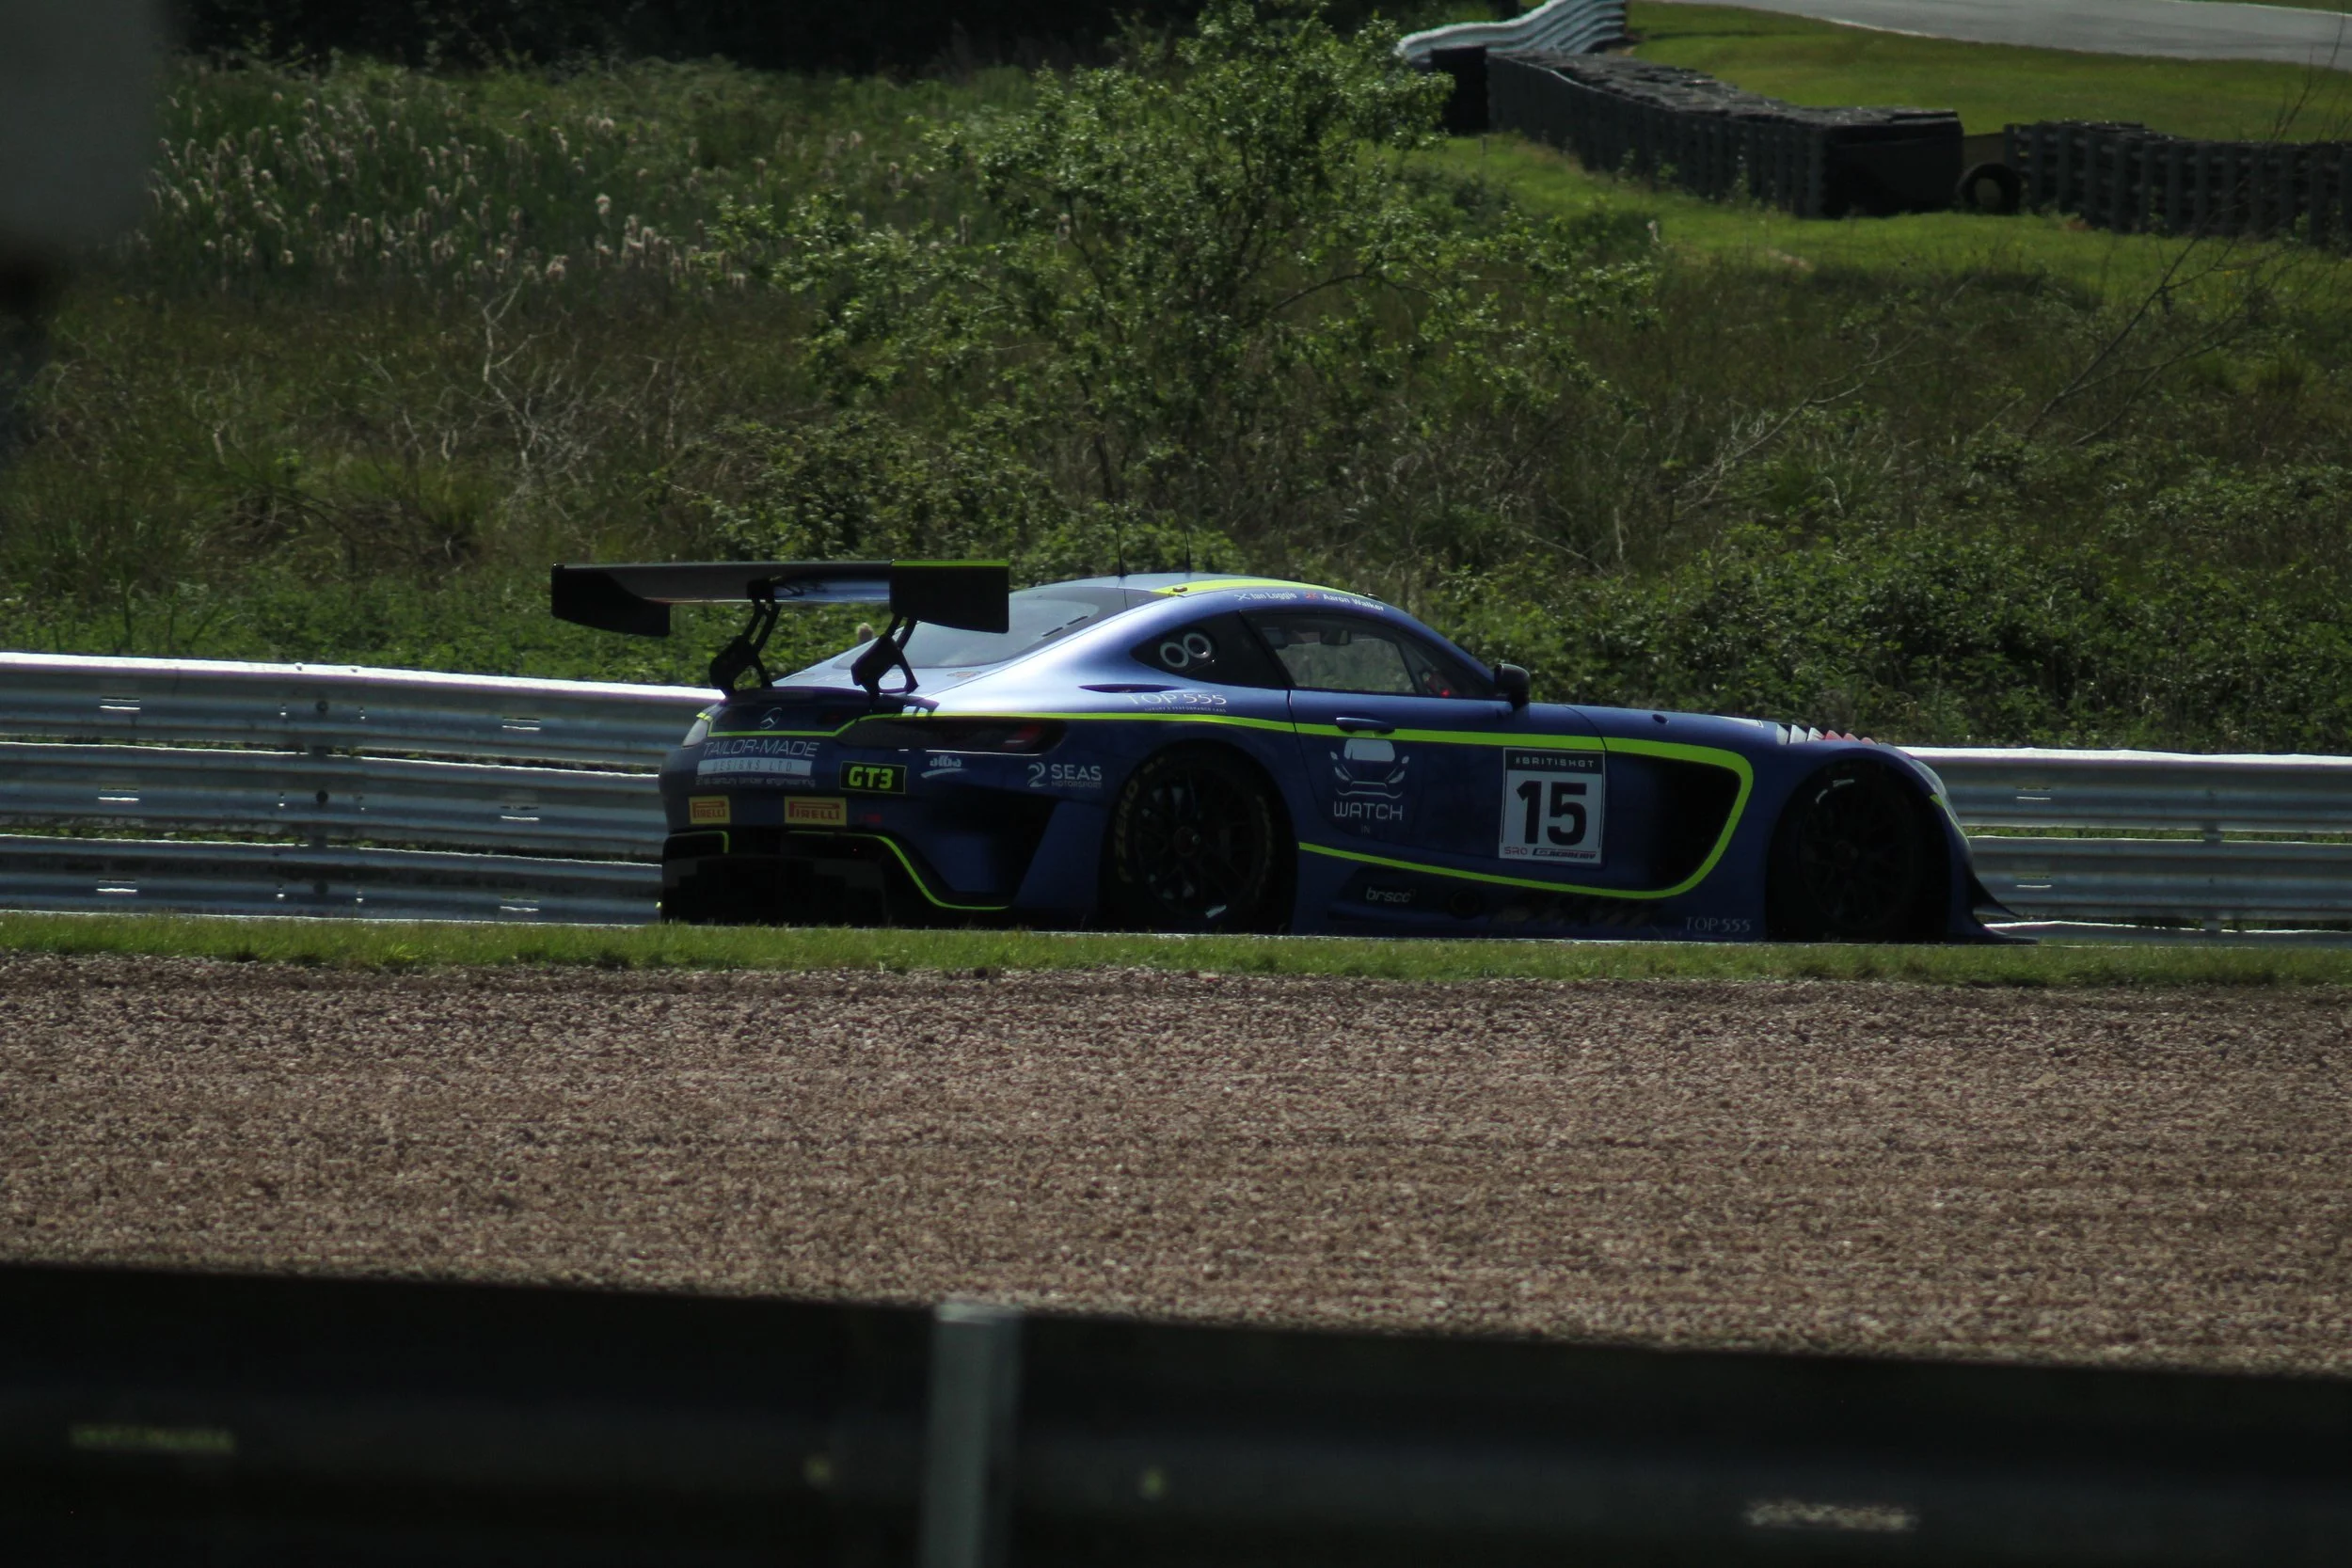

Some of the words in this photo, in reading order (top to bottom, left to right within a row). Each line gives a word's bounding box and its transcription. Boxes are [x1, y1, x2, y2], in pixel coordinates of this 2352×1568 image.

[1267, 592, 1296, 600] Loggie
[1323, 594, 1350, 604] Aaron
[1352, 598, 1384, 611] Walker
[1127, 693, 1177, 705] TOP
[1184, 693, 1227, 705] 555
[704, 739, 820, 757] TAILOR-MADE
[713, 760, 761, 771] DESIGNS
[769, 760, 793, 771] LTD
[1051, 764, 1103, 781] SEAS
[849, 767, 894, 789] GT3
[692, 801, 725, 818] PIRELLI
[789, 801, 840, 820] PIRELLI
[1333, 801, 1403, 821] WATCH
[1516, 781, 1587, 846] 15
[1504, 847, 1528, 855] SRO
[1365, 886, 1411, 903] brscc
[1685, 916, 1718, 932] TOP
[1720, 917, 1753, 933] 555
